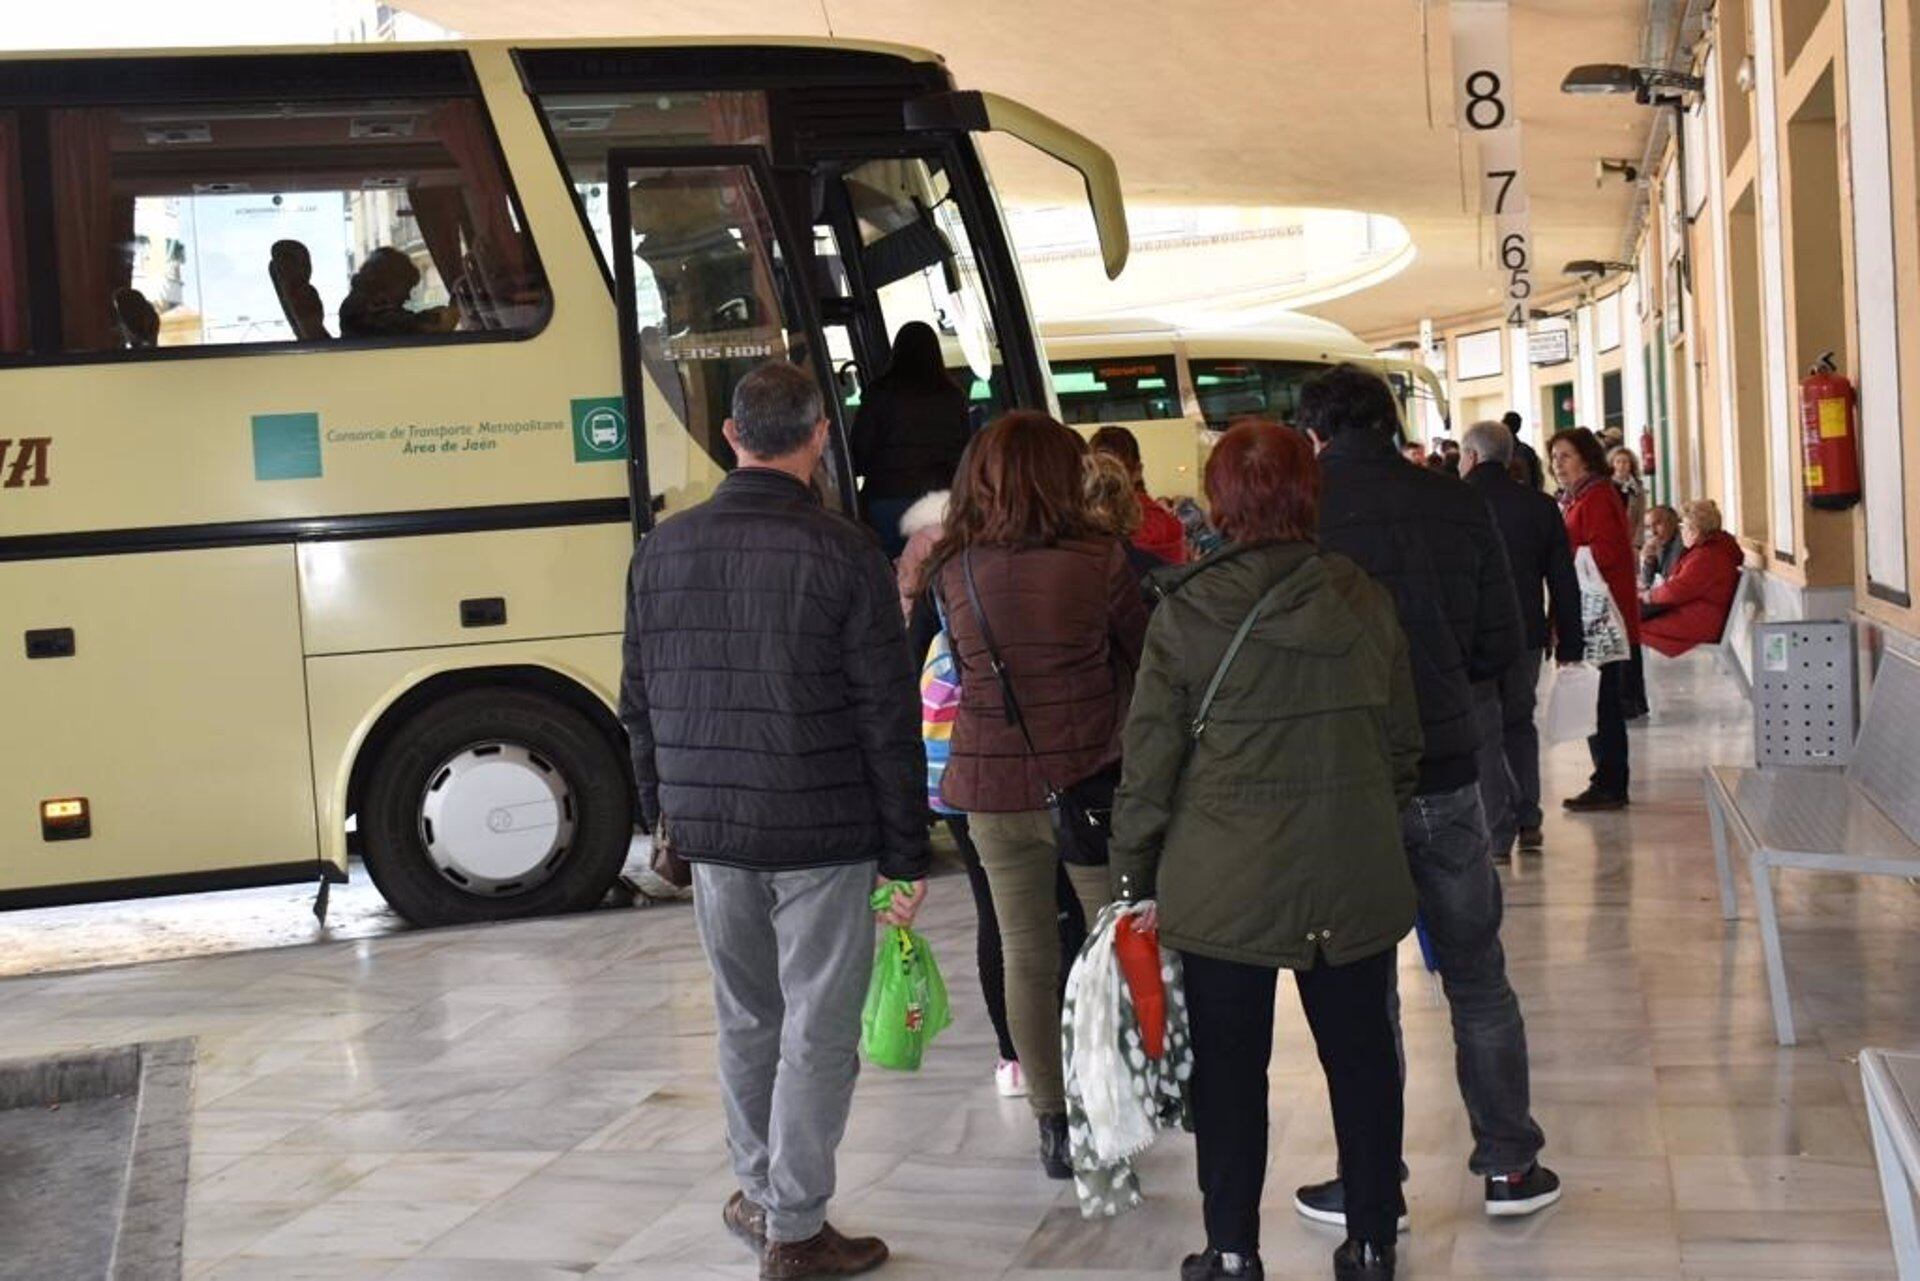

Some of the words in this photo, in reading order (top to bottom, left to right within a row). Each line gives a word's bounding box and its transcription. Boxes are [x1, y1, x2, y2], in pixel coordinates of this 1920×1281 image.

[1466, 70, 1505, 130] 8
[1487, 170, 1516, 214] 7
[1502, 233, 1526, 269] 6
[1510, 269, 1531, 298] 5
[1507, 303, 1525, 328] 4
[390, 426, 404, 438] de
[408, 423, 472, 439] Transporte
[441, 440, 458, 452] de
